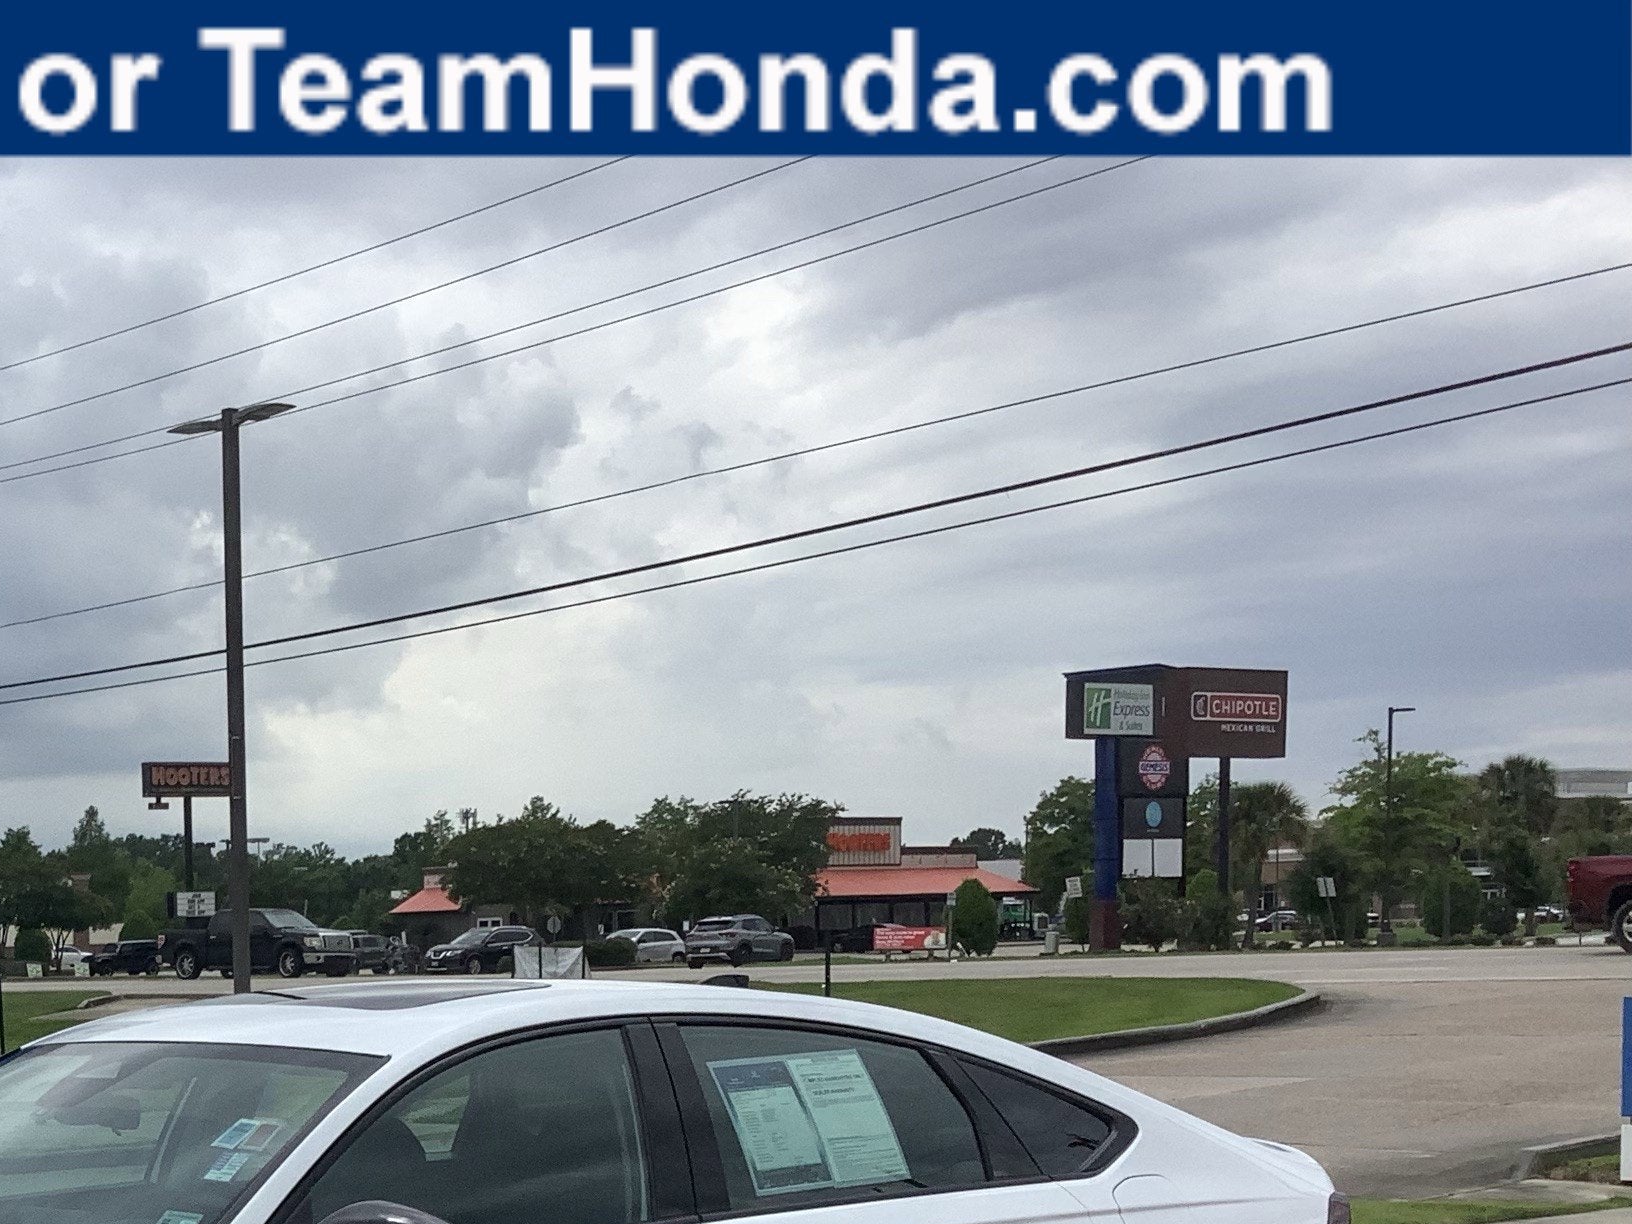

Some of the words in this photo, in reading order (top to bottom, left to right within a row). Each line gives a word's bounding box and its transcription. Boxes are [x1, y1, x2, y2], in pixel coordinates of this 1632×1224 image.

[1112, 701, 1150, 719] Express
[1212, 699, 1278, 716] CHIPOTLE
[1220, 723, 1254, 732] MEXICAN
[151, 766, 230, 786] HOOTERS
